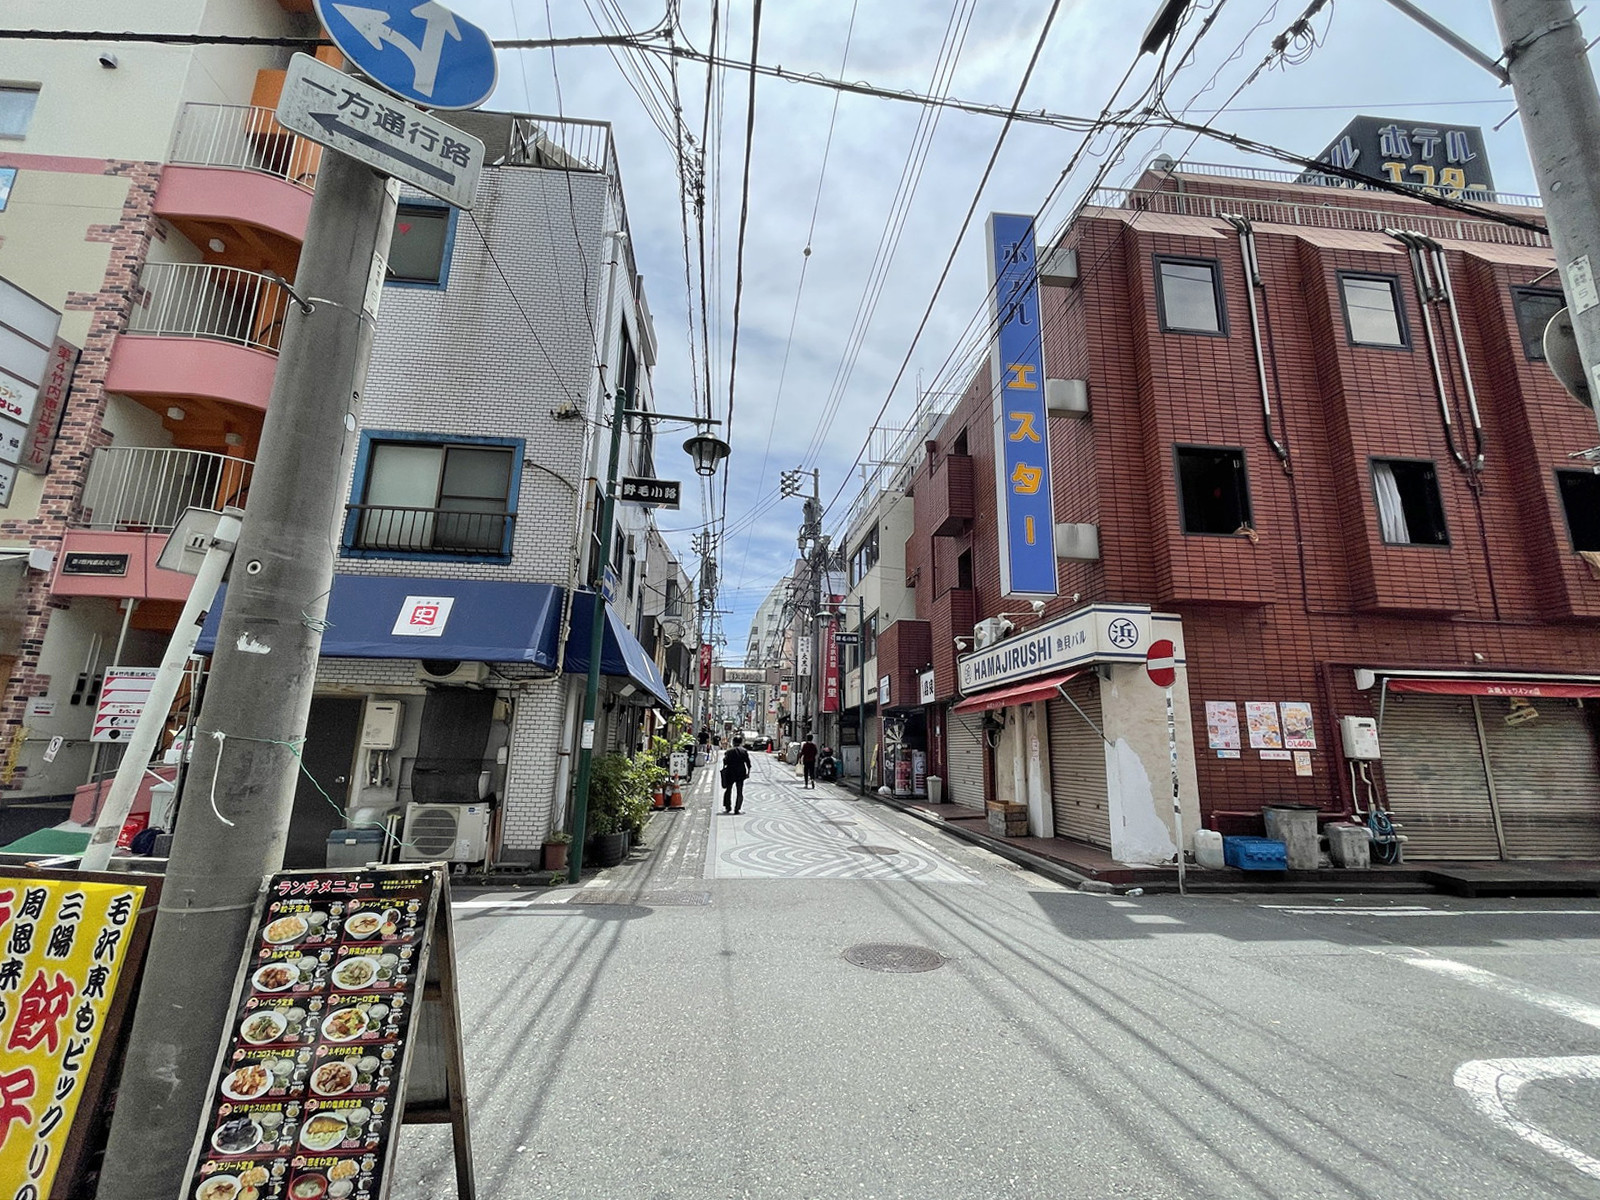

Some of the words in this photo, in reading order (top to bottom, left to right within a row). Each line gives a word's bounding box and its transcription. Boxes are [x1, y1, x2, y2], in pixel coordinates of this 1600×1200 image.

[301, 77, 471, 168] 一方通行路
[1378, 123, 1477, 165] ホテル
[1001, 242, 1034, 326] ホテル
[1006, 362, 1043, 546] エスター
[623, 483, 677, 499] 野毛小路
[411, 606, 437, 625] 史
[1056, 630, 1086, 652] 魚貝バル
[1110, 620, 1136, 646] 浜
[974, 635, 1052, 680] HAMAJIRUSHI
[278, 880, 374, 896] ランチメニュー
[280, 904, 311, 913] 餃子定食
[47, 892, 84, 958] 三陽
[260, 998, 294, 1006] レバニラ定食
[339, 994, 380, 1003] ホイコーロ定食
[246, 1049, 296, 1058] サイコロステーキ定食
[217, 1160, 254, 1171] エリート定食
